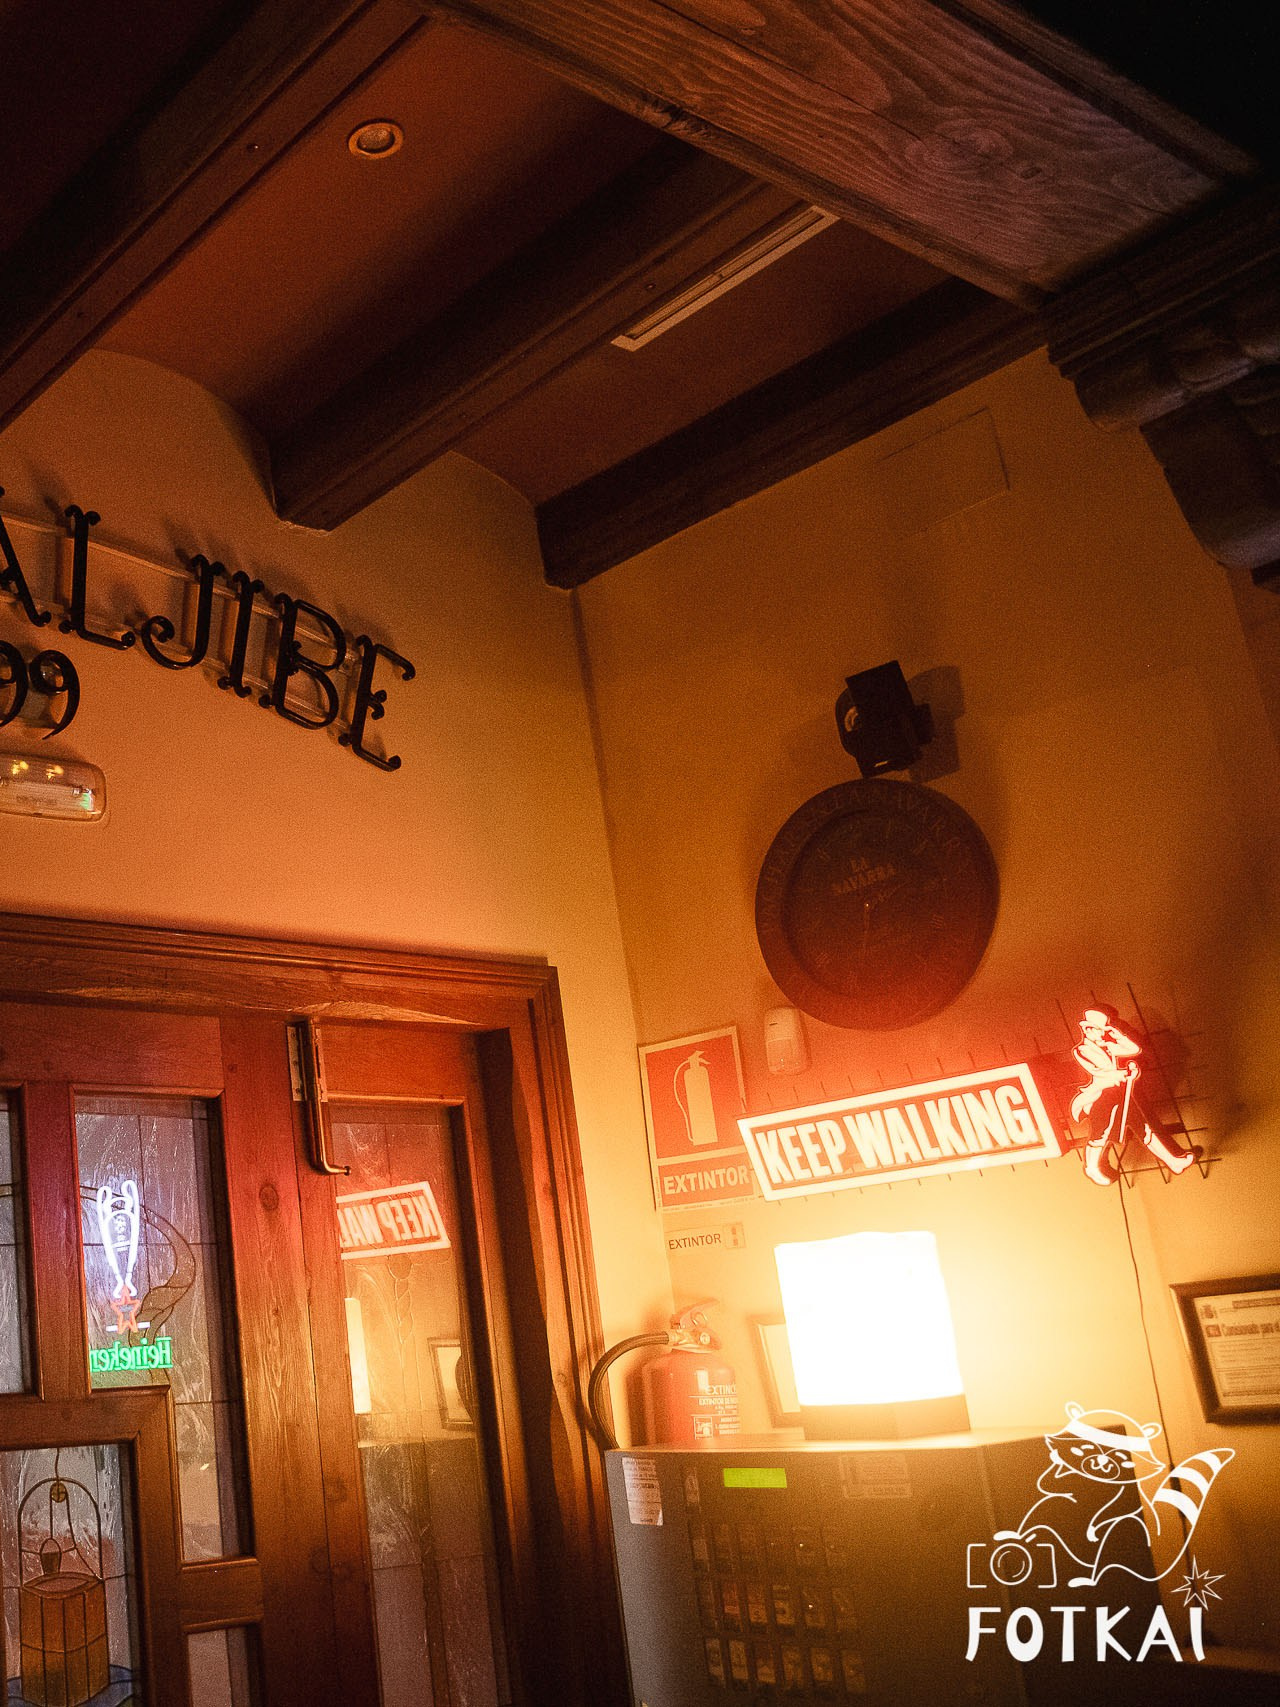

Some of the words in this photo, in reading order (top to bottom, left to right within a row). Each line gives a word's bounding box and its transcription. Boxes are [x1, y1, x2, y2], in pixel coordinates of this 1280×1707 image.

[755, 1119, 847, 1185] KEEP
[842, 1085, 1040, 1169] WALKING
[663, 1165, 750, 1195] EXTINTOR
[668, 1233, 722, 1250] EXTINTOR
